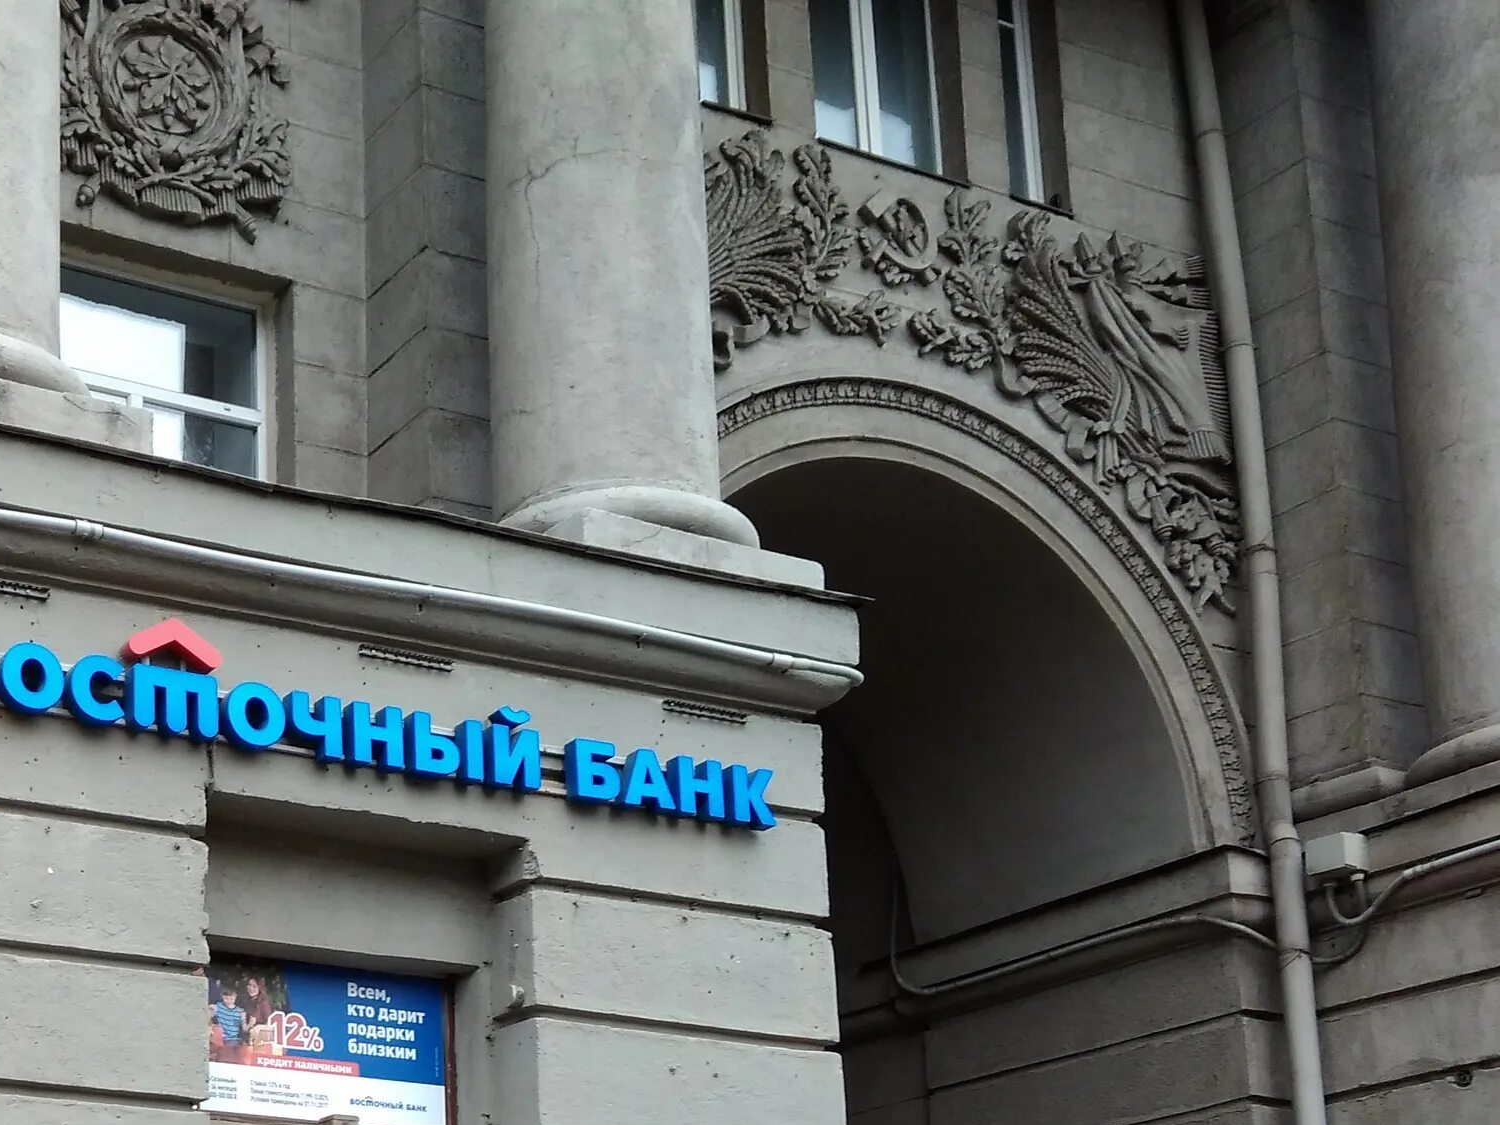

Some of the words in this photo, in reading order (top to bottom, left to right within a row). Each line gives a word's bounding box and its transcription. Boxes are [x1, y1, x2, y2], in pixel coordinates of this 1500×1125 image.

[563, 737, 778, 831] БАНК
[347, 981, 391, 1004] Всем,
[347, 1003, 375, 1018] кто
[377, 1007, 426, 1025] дарит
[268, 1011, 325, 1052] 12%
[347, 1022, 416, 1042] подарки
[348, 1038, 417, 1061] близким
[257, 1056, 293, 1069] кредит
[294, 1059, 353, 1074] наличными
[406, 1103, 428, 1112] БАНК
